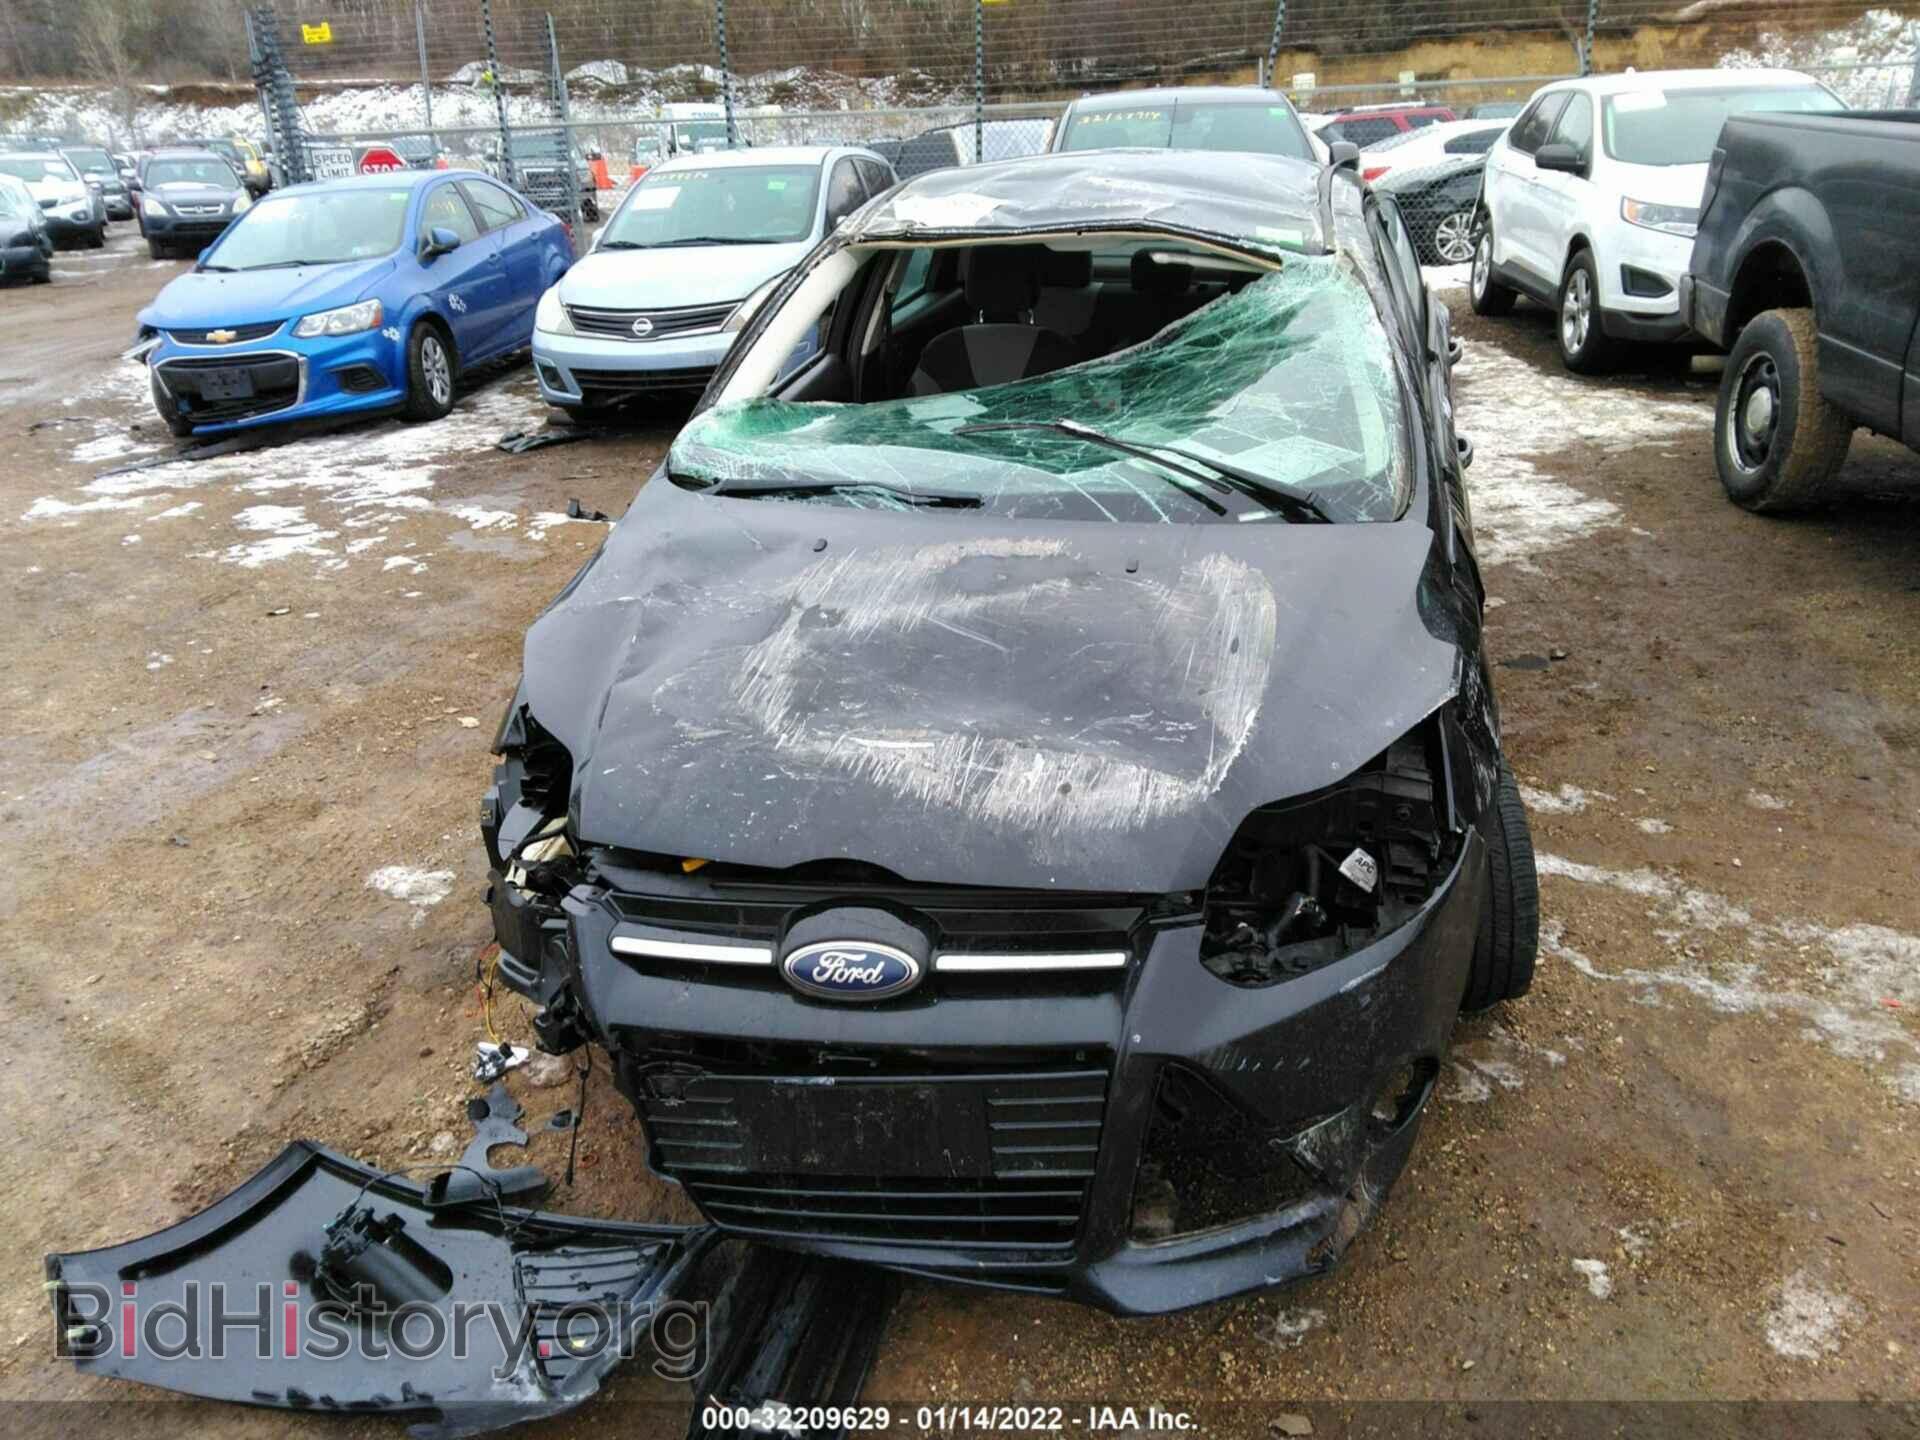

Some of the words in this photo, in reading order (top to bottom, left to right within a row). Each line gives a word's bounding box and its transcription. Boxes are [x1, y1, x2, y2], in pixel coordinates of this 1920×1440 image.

[314, 153, 352, 165] SPEED
[320, 167, 350, 178] LIMIT
[811, 950, 886, 984] Ford
